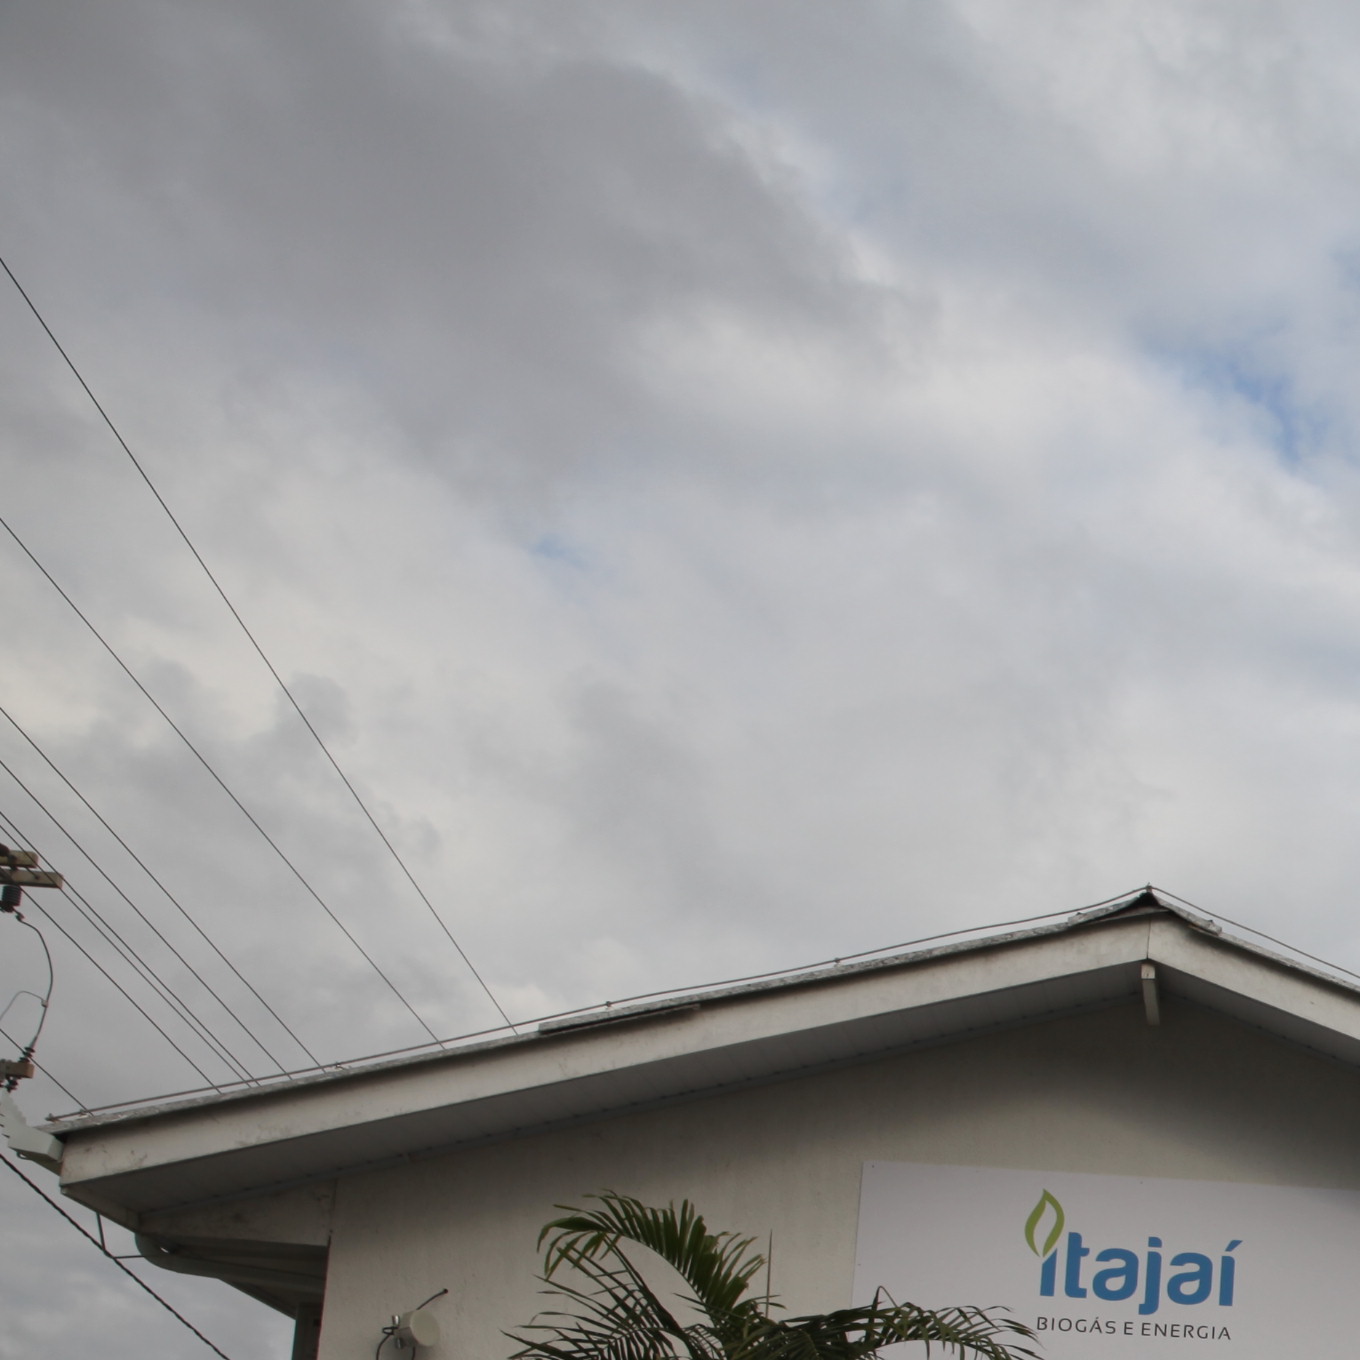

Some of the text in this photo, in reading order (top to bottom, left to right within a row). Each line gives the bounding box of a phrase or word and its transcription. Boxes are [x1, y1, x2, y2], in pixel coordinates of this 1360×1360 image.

[1036, 1316, 1232, 1340] BIOGÁS E ENERGIA
